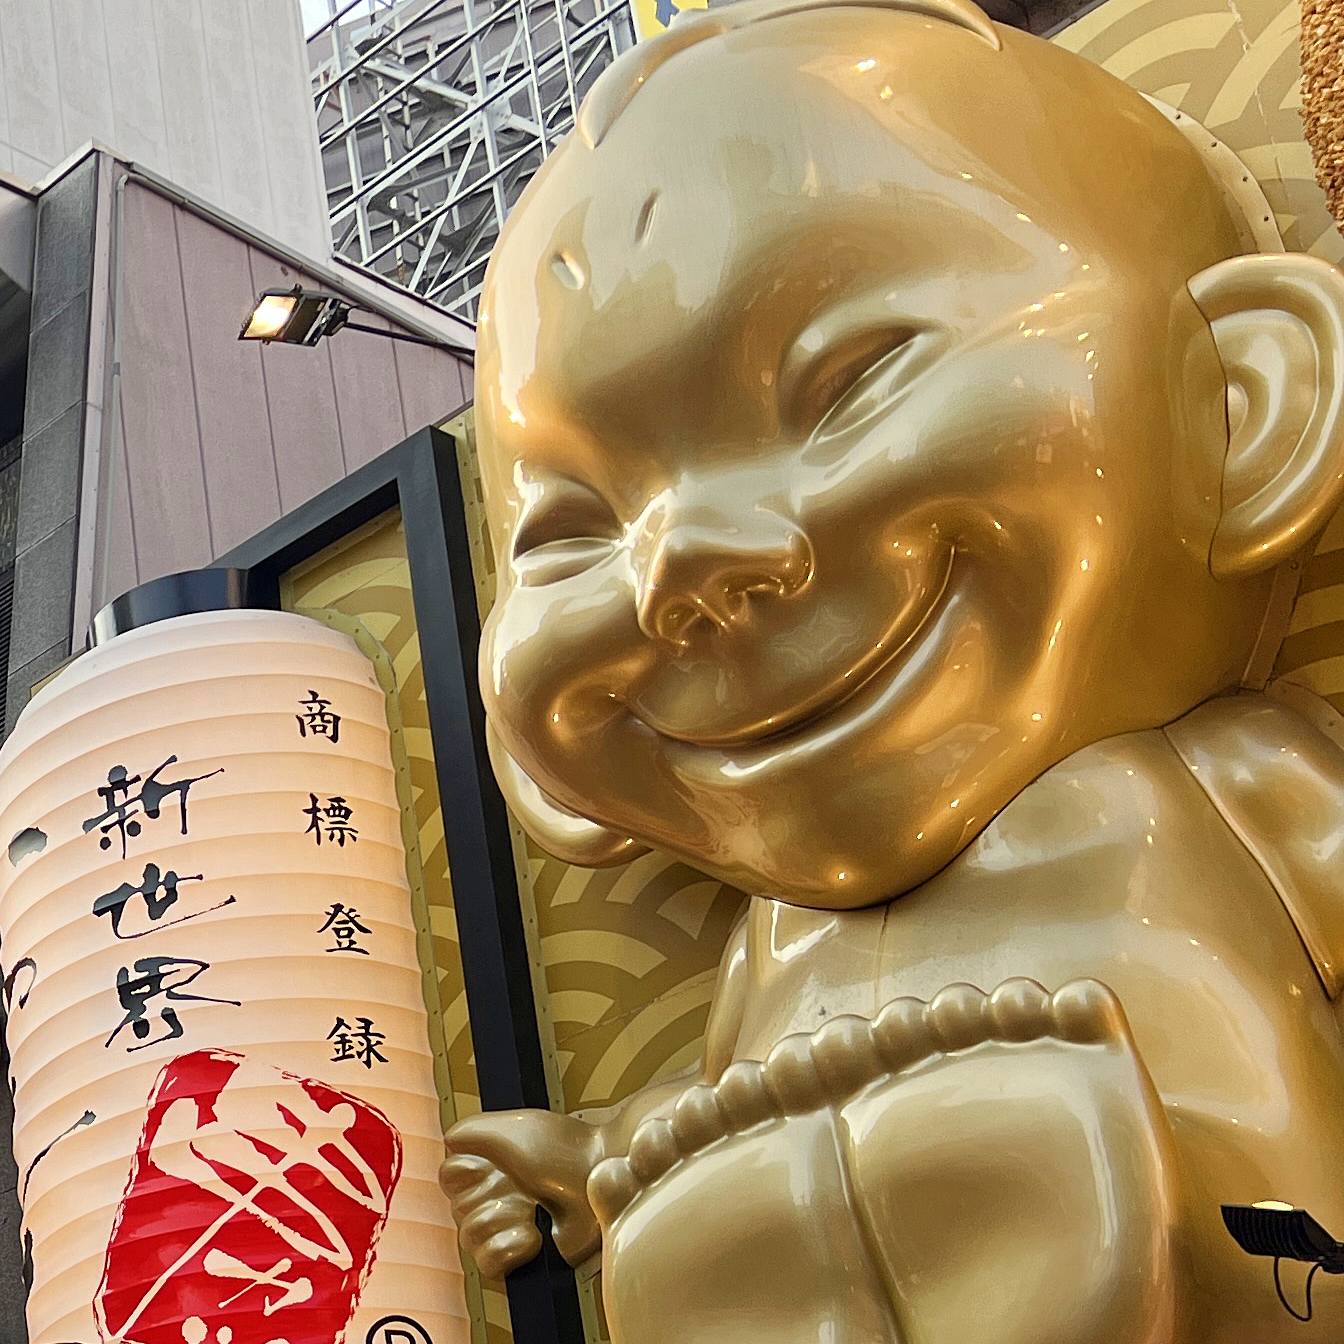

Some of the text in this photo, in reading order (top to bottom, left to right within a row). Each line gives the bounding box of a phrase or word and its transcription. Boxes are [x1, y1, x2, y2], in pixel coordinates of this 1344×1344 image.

[81, 754, 241, 1052] 新世界
[294, 688, 388, 1070] 商標登録
